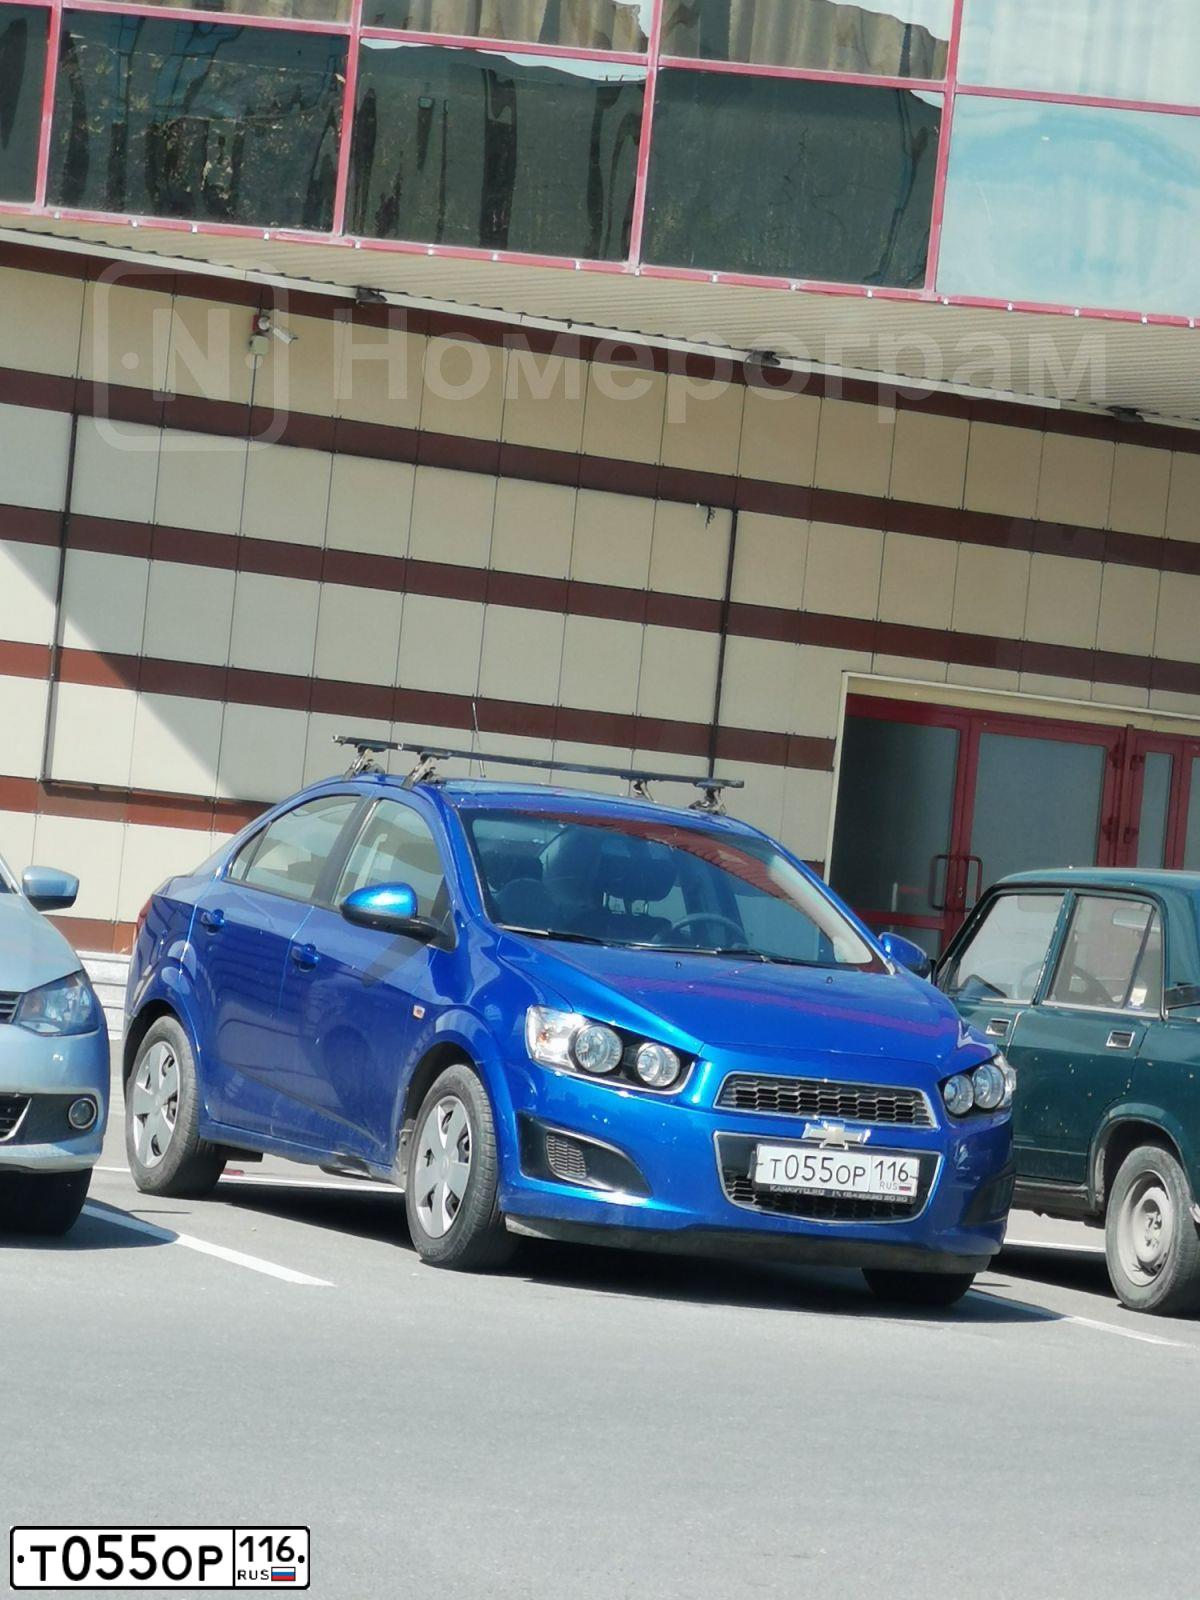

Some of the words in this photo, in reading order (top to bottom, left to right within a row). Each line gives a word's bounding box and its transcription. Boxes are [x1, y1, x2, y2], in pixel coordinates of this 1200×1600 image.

[770, 1154, 866, 1186] Т055ОР
[874, 1160, 909, 1183] 116
[879, 1181, 898, 1190] RUS
